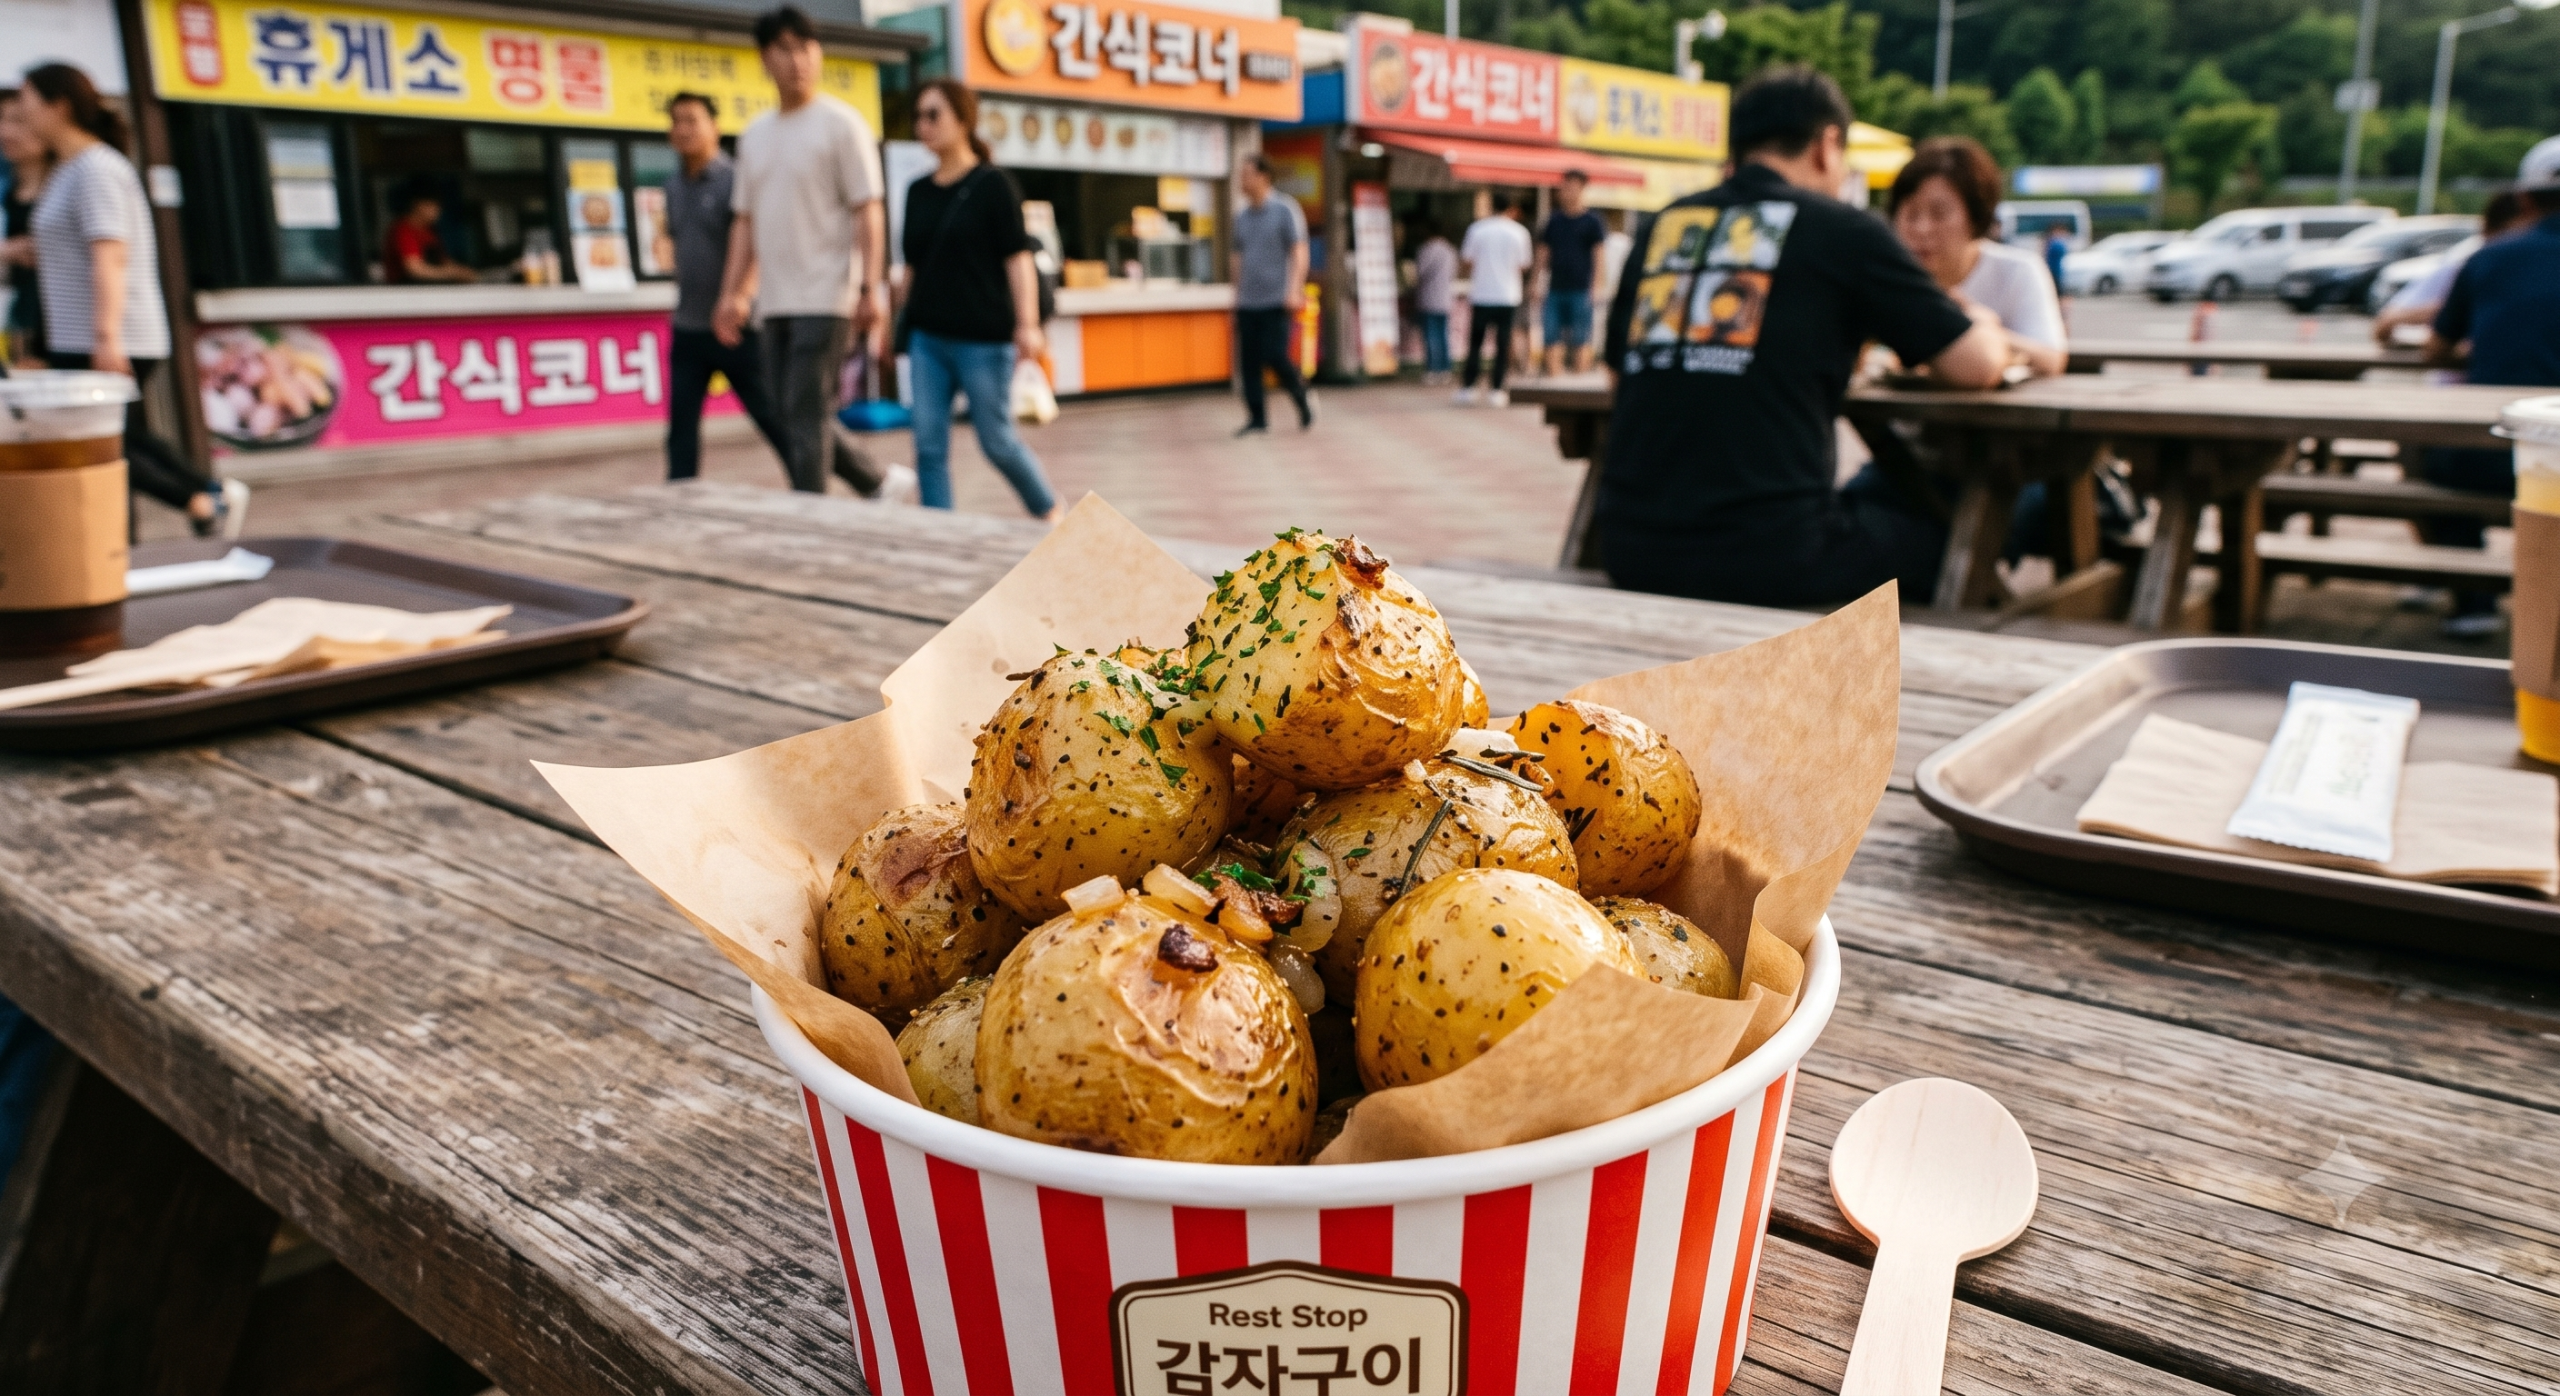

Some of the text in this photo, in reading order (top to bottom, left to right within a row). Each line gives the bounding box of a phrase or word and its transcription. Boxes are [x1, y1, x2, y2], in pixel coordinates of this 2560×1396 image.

[252, 13, 463, 96] 휴게소
[488, 35, 606, 111] 명물
[1051, 3, 1240, 96] 간식코너
[1411, 48, 1555, 133] 간식코너
[366, 331, 662, 422] 간식코너
[1208, 1302, 1368, 1332] Rest Stop
[1155, 1336, 1421, 1396] 감자구이
